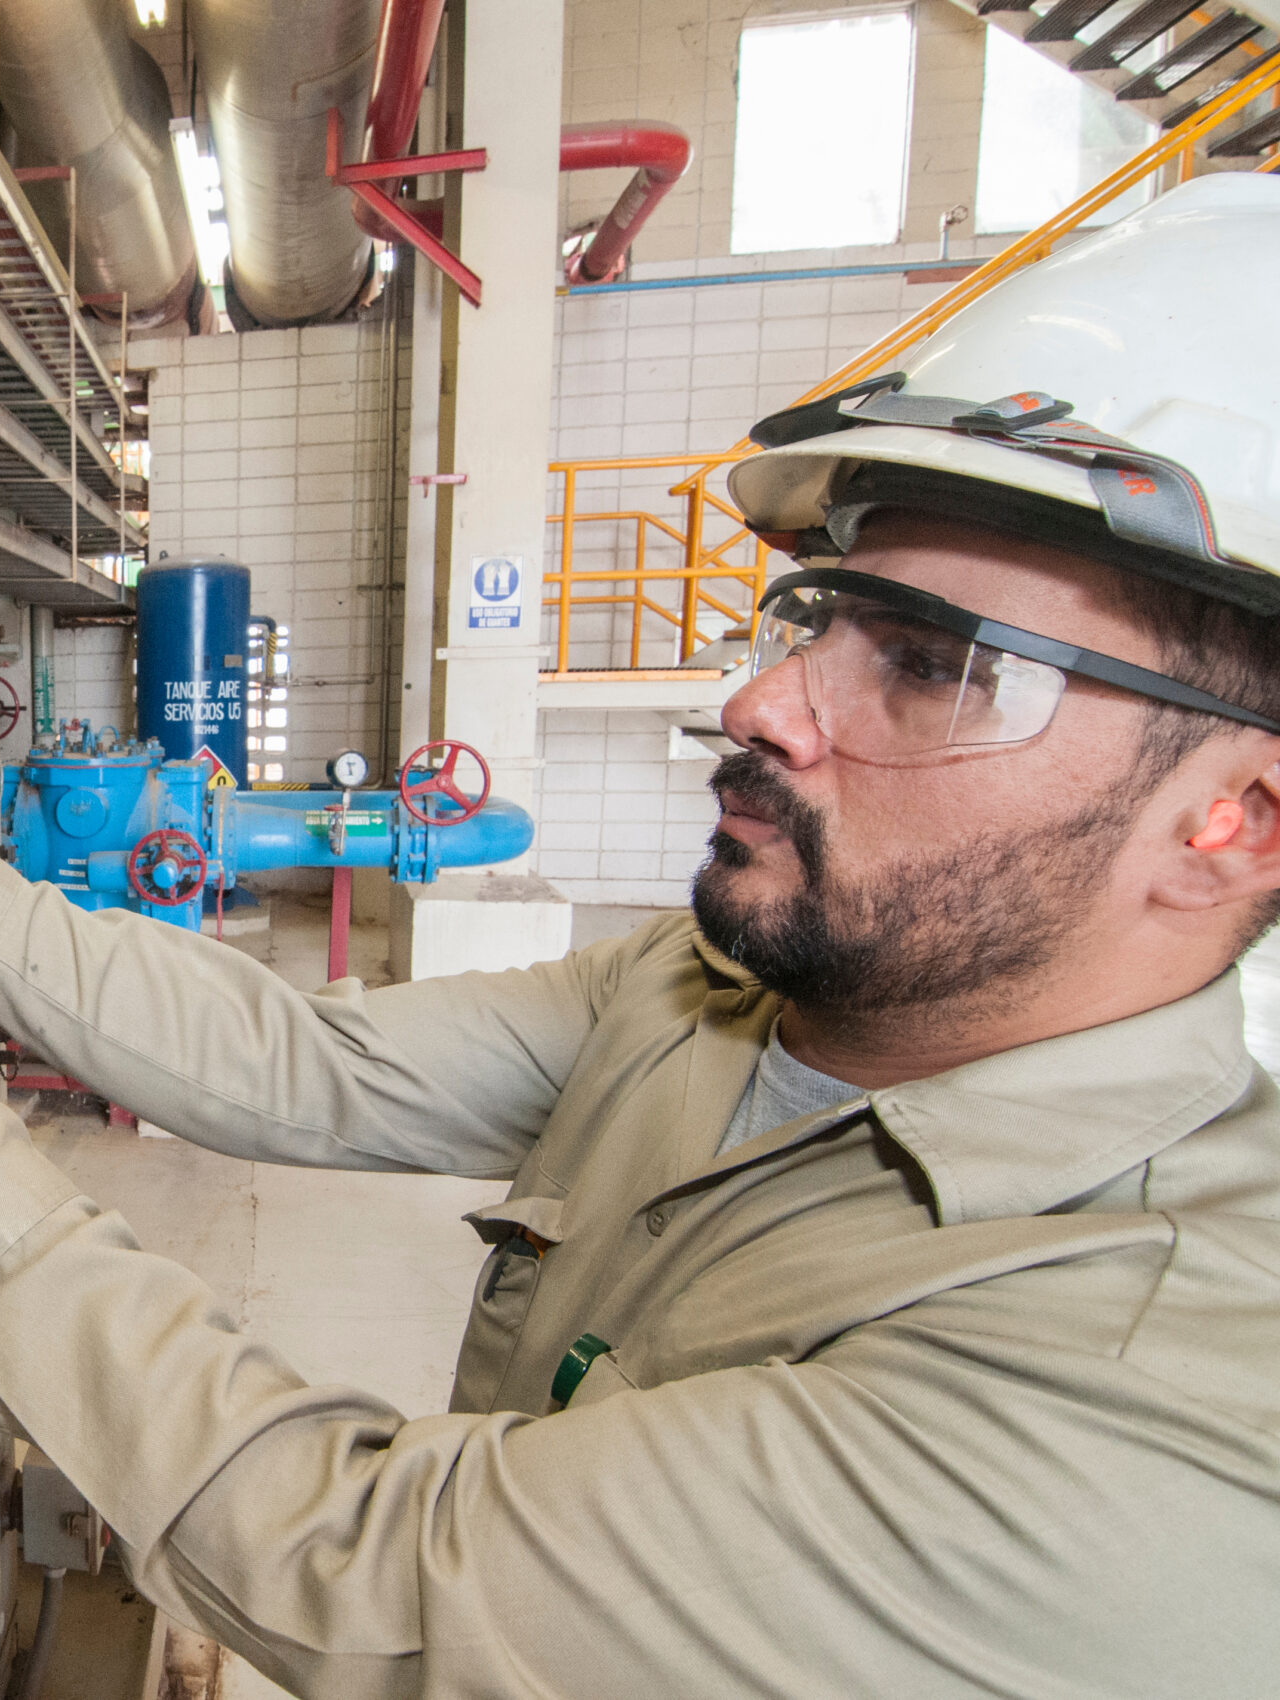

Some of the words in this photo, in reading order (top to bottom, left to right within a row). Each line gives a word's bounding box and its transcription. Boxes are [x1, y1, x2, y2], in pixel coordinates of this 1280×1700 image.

[164, 681, 212, 700] TANQUE
[217, 680, 240, 699] AIRE
[164, 702, 224, 721] SERVICIOS
[228, 702, 241, 720] U5
